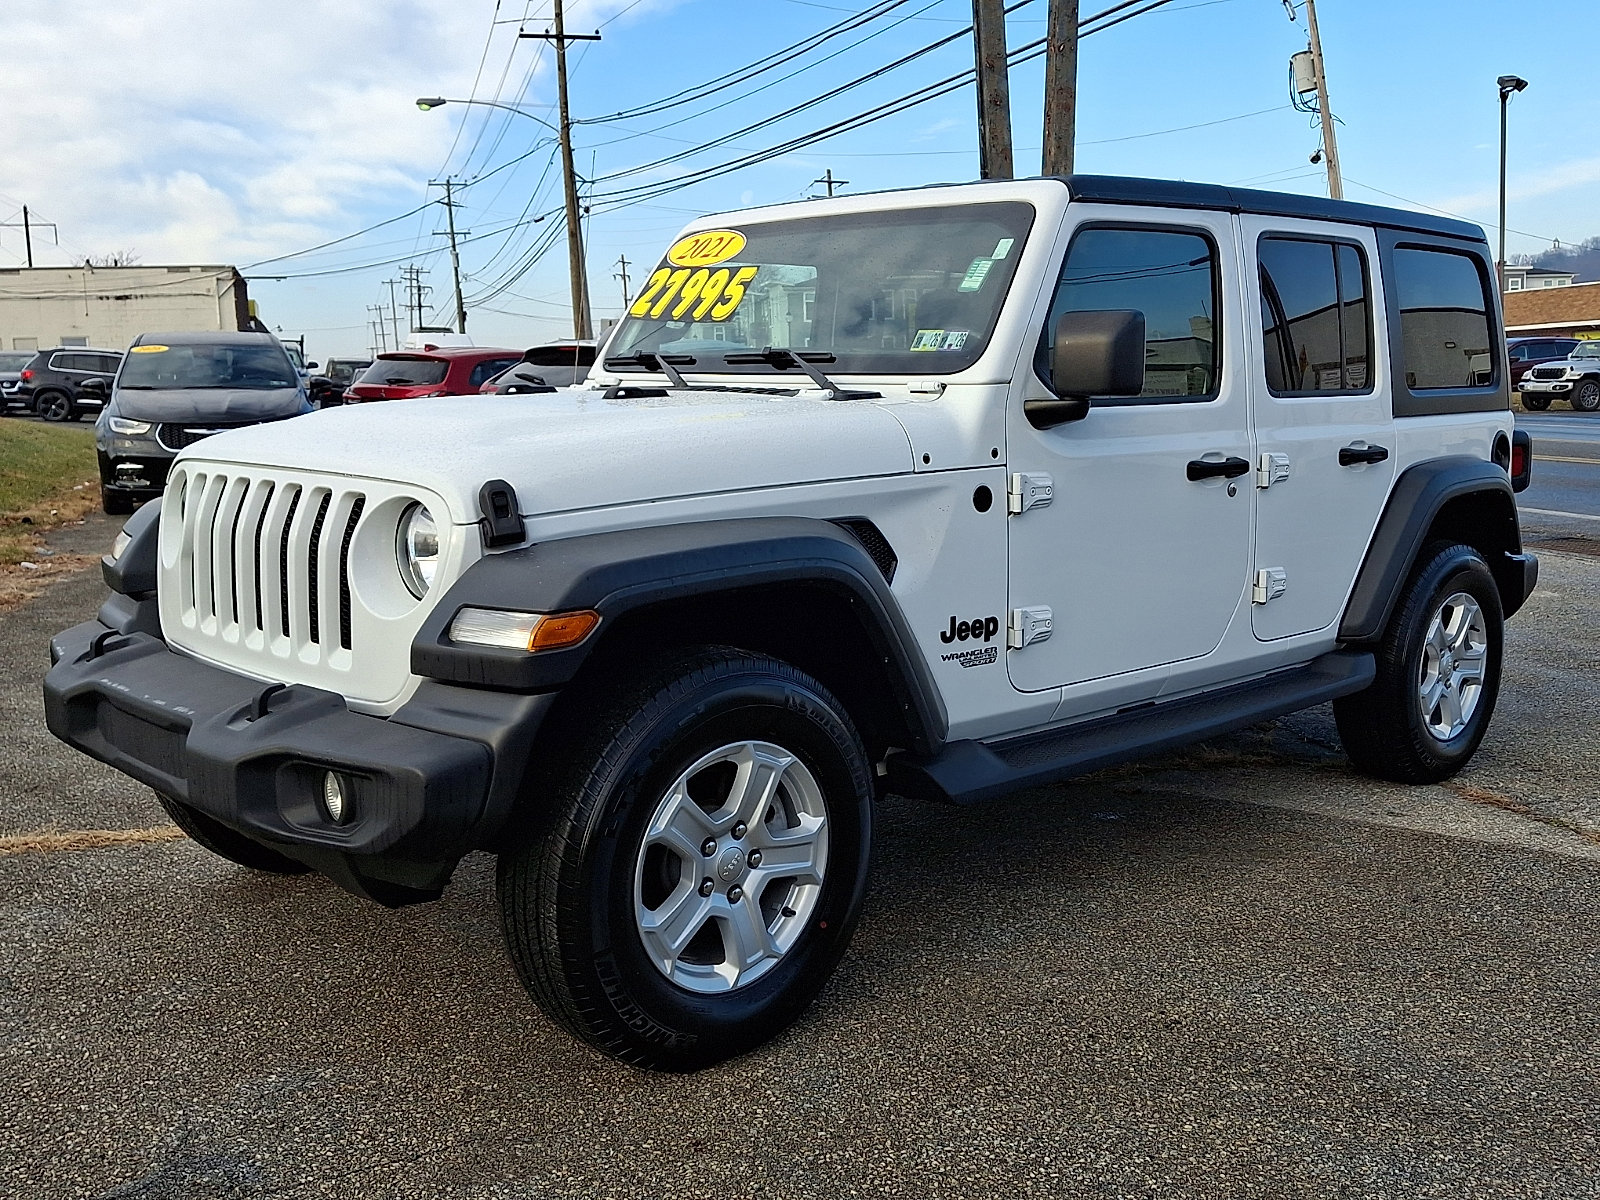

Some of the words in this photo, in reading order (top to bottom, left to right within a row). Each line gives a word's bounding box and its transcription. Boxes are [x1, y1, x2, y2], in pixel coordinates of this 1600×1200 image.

[675, 236, 738, 260] 2021
[629, 266, 759, 323] 27995
[940, 615, 999, 644] Jeep
[940, 646, 998, 662] WRANGLER
